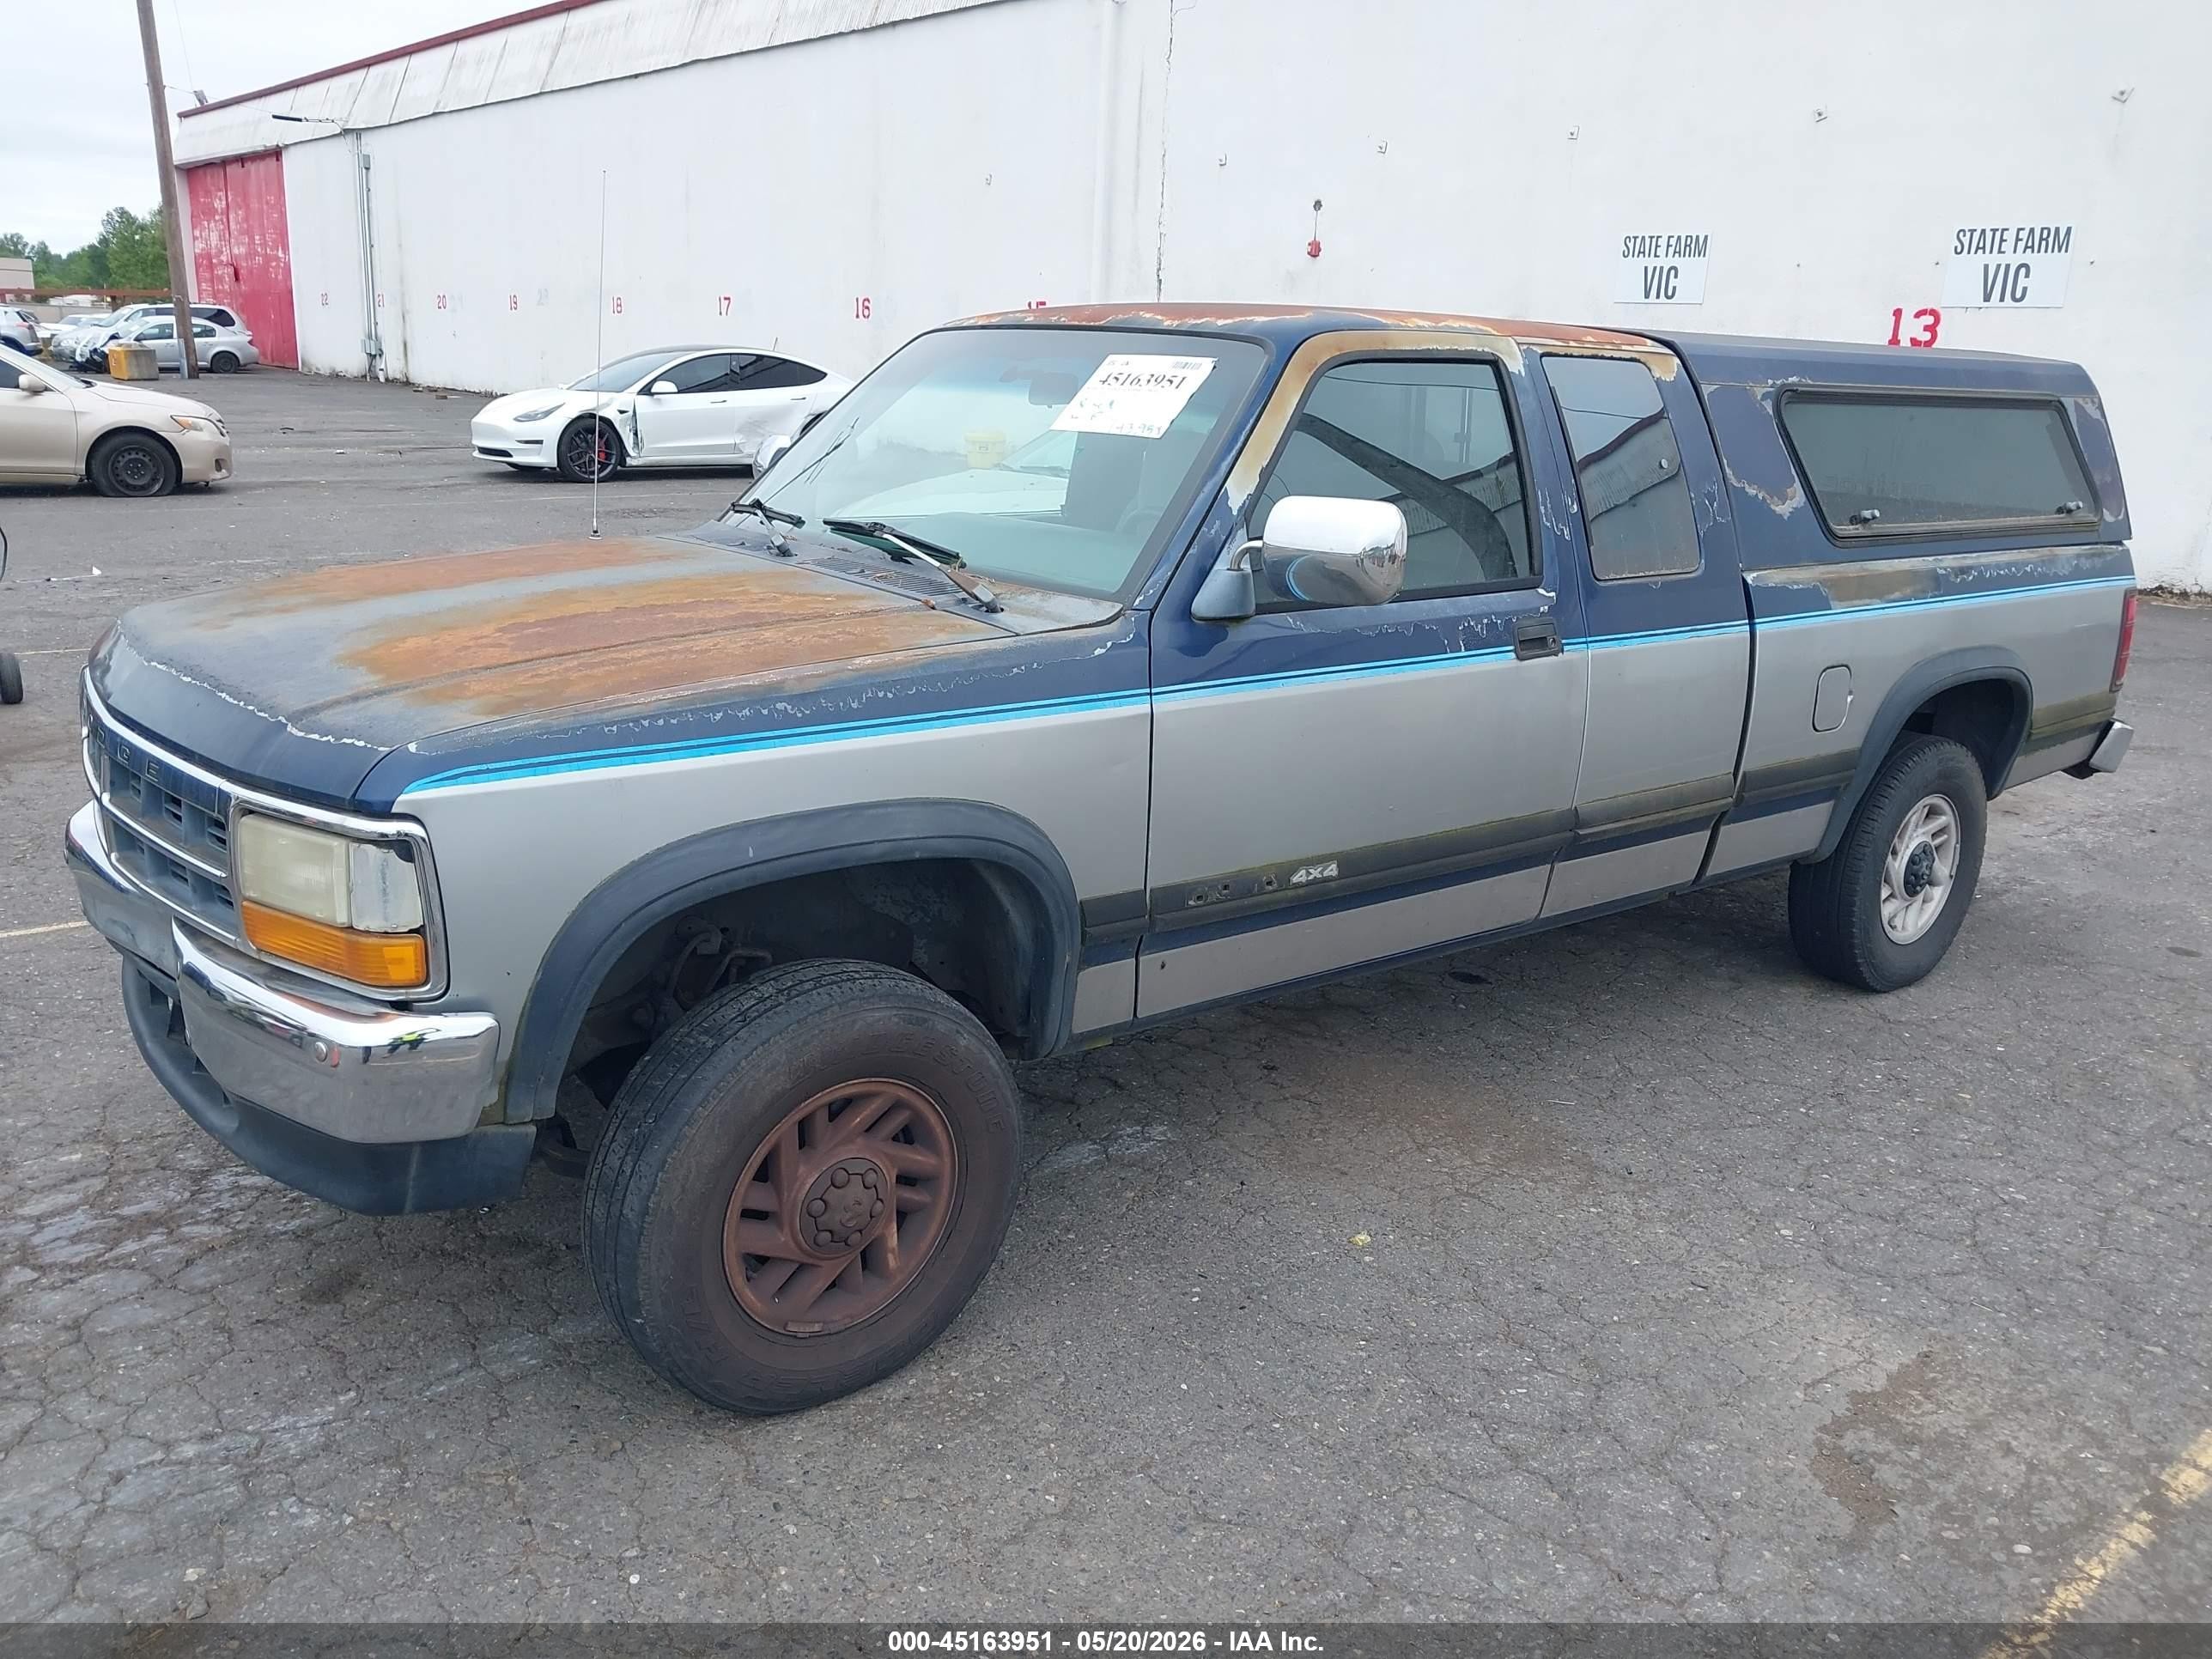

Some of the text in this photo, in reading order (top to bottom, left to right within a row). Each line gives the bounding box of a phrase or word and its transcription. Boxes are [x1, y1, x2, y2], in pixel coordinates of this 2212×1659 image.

[1622, 234, 1708, 258] STATE FARM
[1954, 226, 2072, 255] STATE FARM
[1644, 265, 1679, 300] VIC
[1983, 262, 2031, 303] VIC
[437, 295, 447, 309] 20
[509, 295, 518, 311] 19
[612, 296, 623, 314] 18
[719, 296, 731, 316] 17
[855, 297, 871, 319] 16
[1887, 307, 1942, 347] 13
